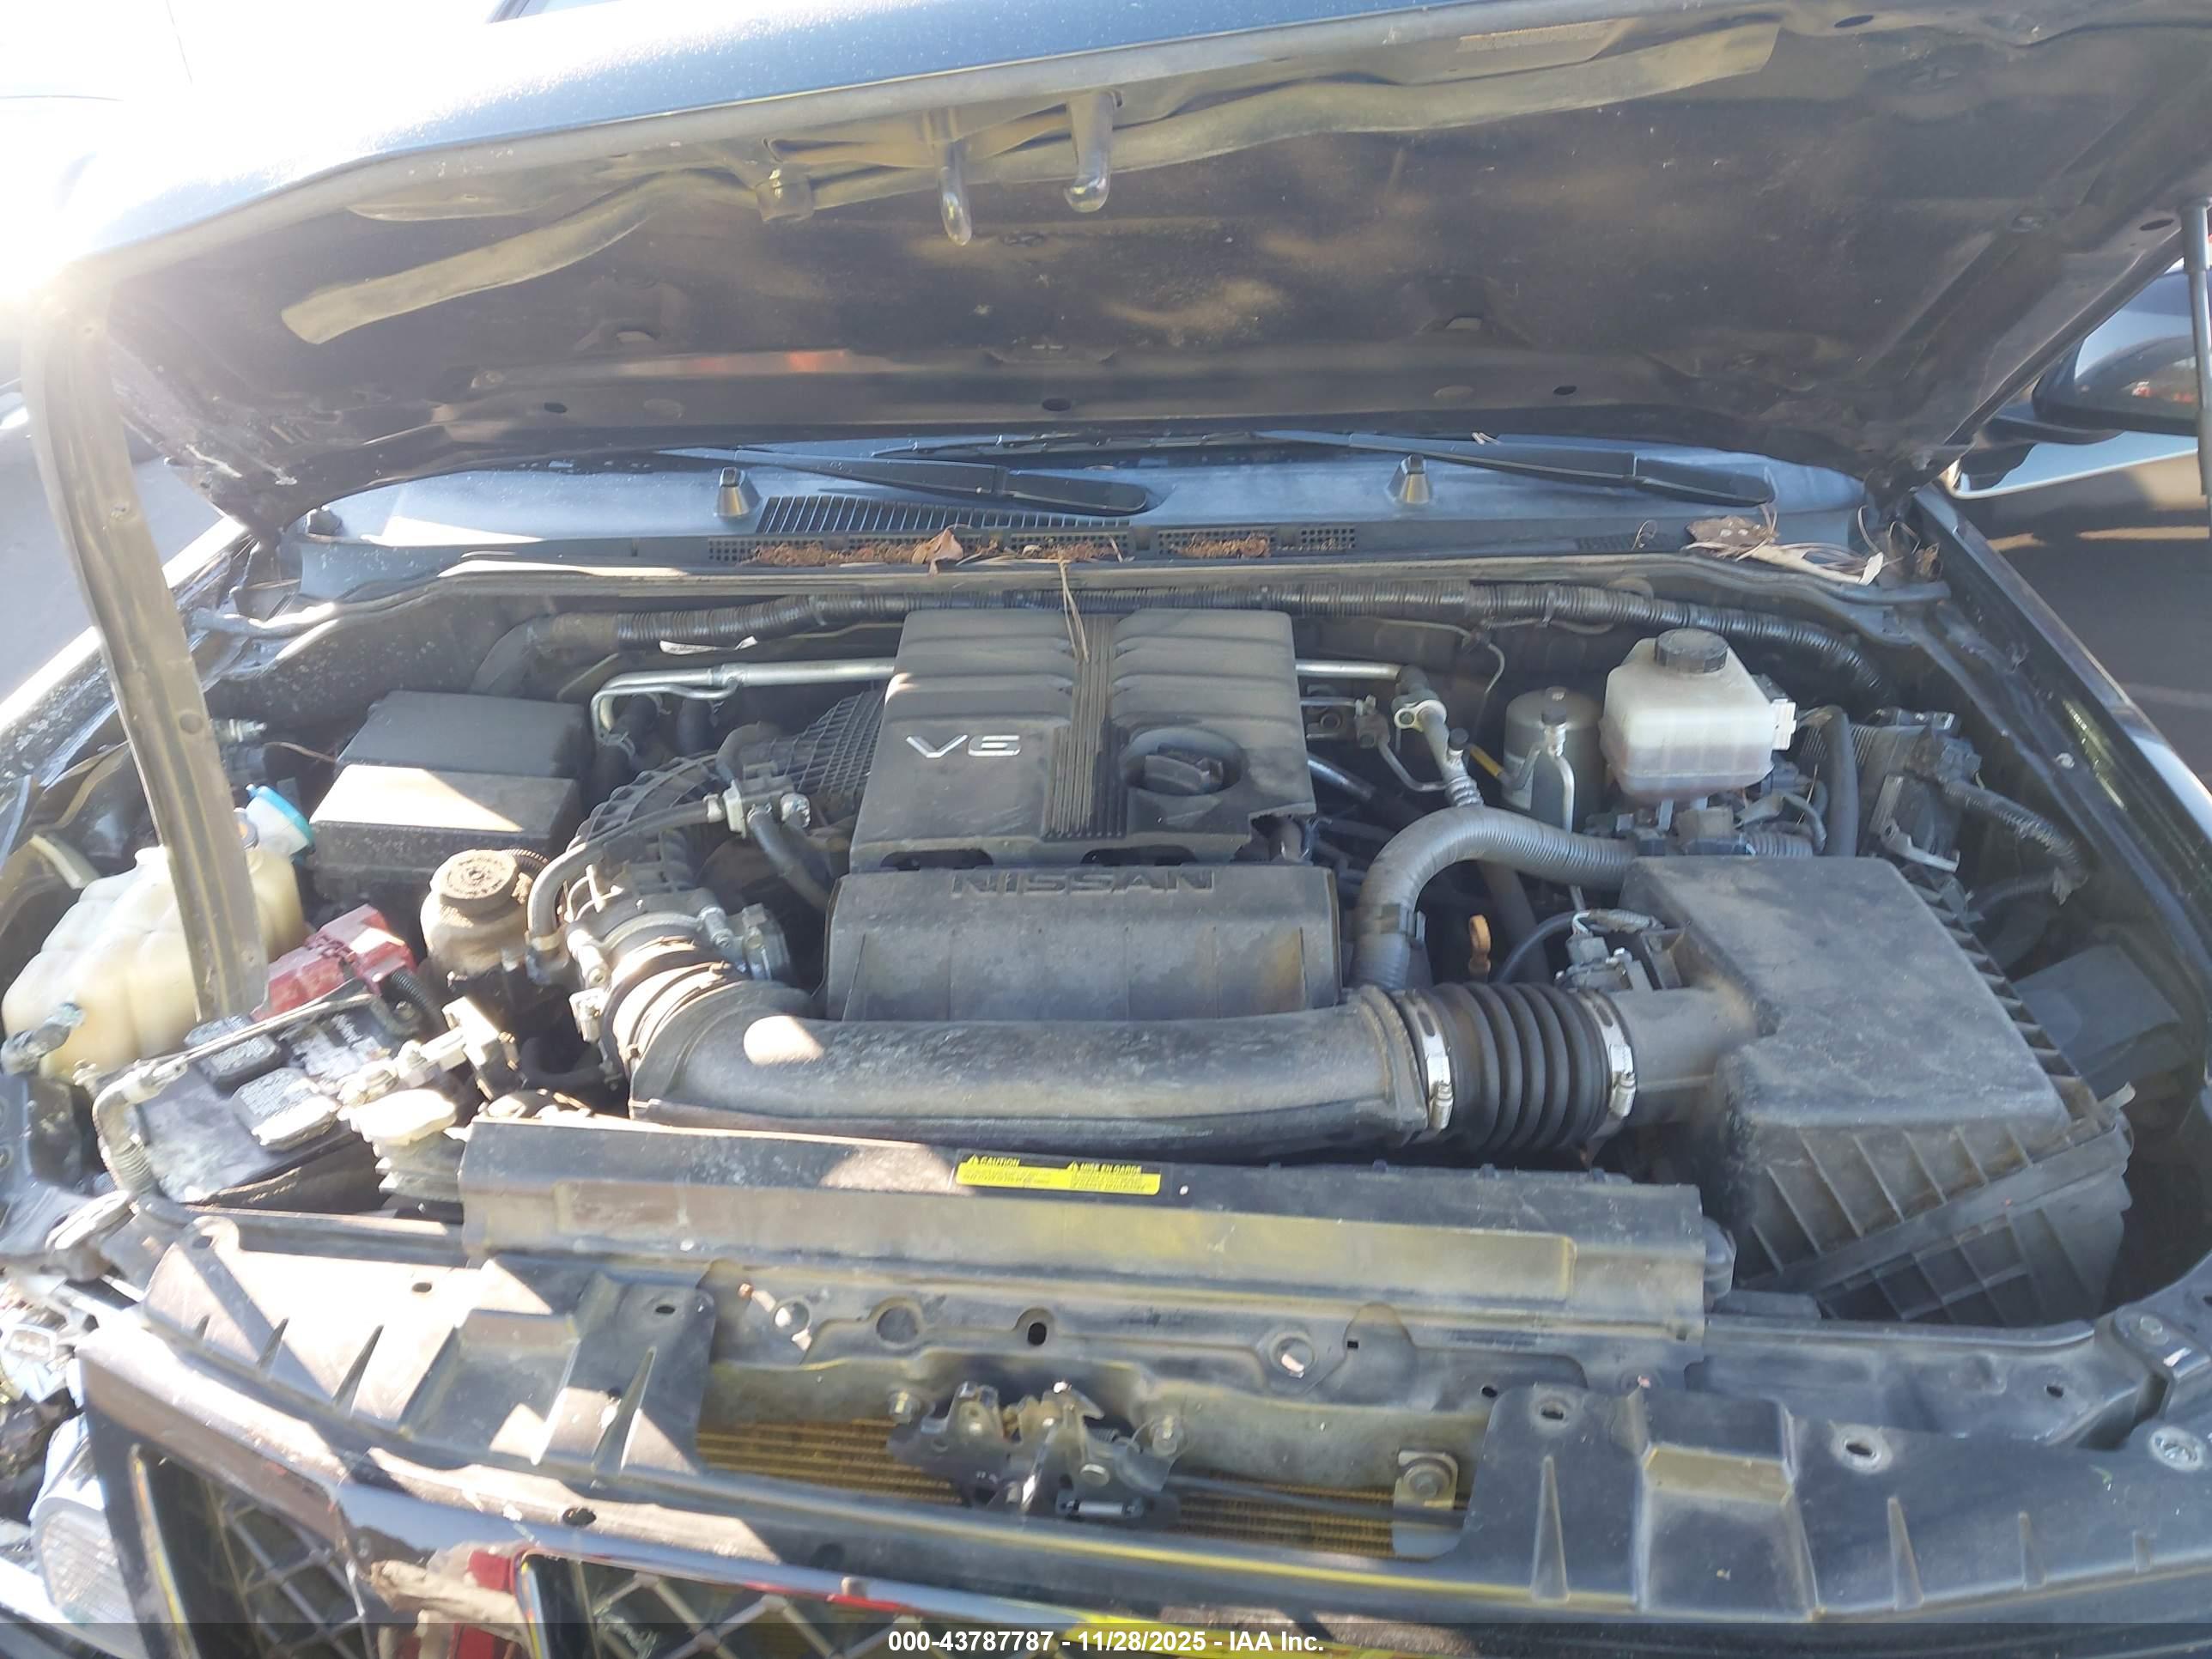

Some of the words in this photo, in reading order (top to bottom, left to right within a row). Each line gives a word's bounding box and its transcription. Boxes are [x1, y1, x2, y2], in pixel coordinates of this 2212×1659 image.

[906, 734, 1022, 759] V6
[951, 869, 1216, 898] NISSAN
[980, 1156, 1021, 1168] CAUTION
[1113, 1164, 1143, 1176] GARDE
